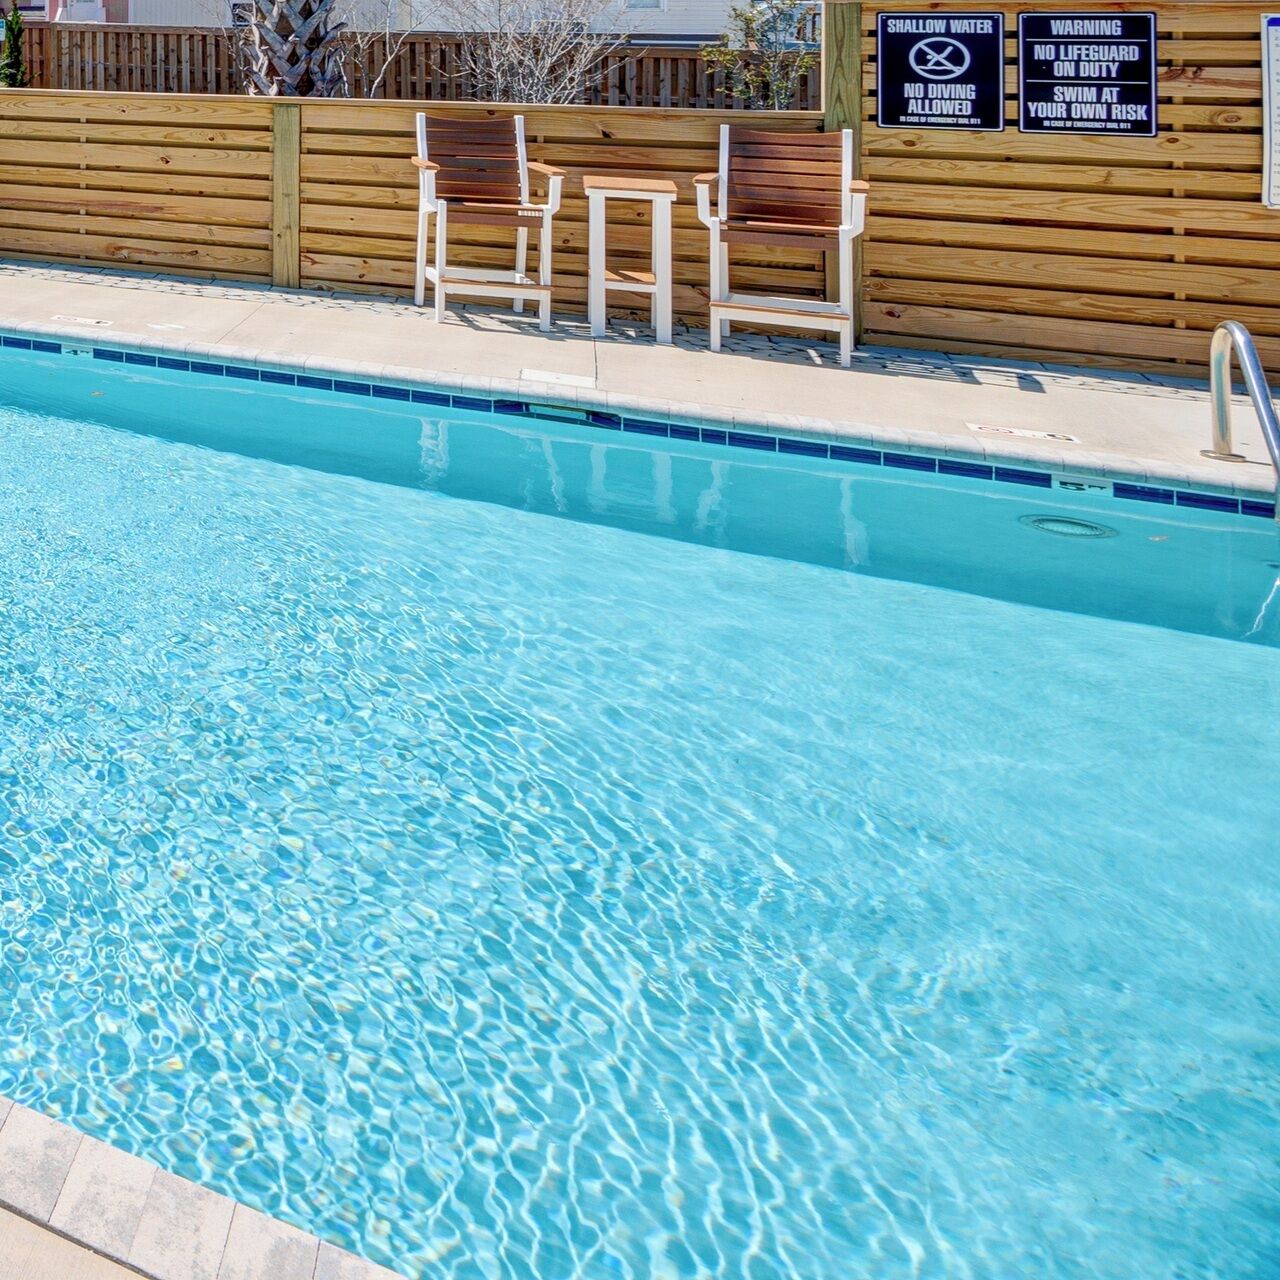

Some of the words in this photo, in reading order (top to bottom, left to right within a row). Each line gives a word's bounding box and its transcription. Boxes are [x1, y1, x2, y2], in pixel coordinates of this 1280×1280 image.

[887, 19, 946, 33] SHALLOW
[950, 19, 993, 34] WATER
[1050, 19, 1122, 36] WARNING
[1034, 44, 1055, 60] NO
[1060, 45, 1139, 61] LIFEGUARD
[1053, 61, 1075, 77] ON
[1079, 62, 1119, 77] DUTY
[903, 83, 924, 98] NO
[927, 83, 976, 100] DIVING
[1053, 86, 1097, 102] SWIM
[1101, 87, 1120, 103] AT
[907, 99, 972, 115] ALLOWED
[1027, 102, 1067, 118] YOUR
[1071, 103, 1107, 119] OWN
[1111, 104, 1148, 120] RISK
[927, 116, 957, 124] EMERGENCY
[1073, 121, 1106, 129] EMERGENCY
